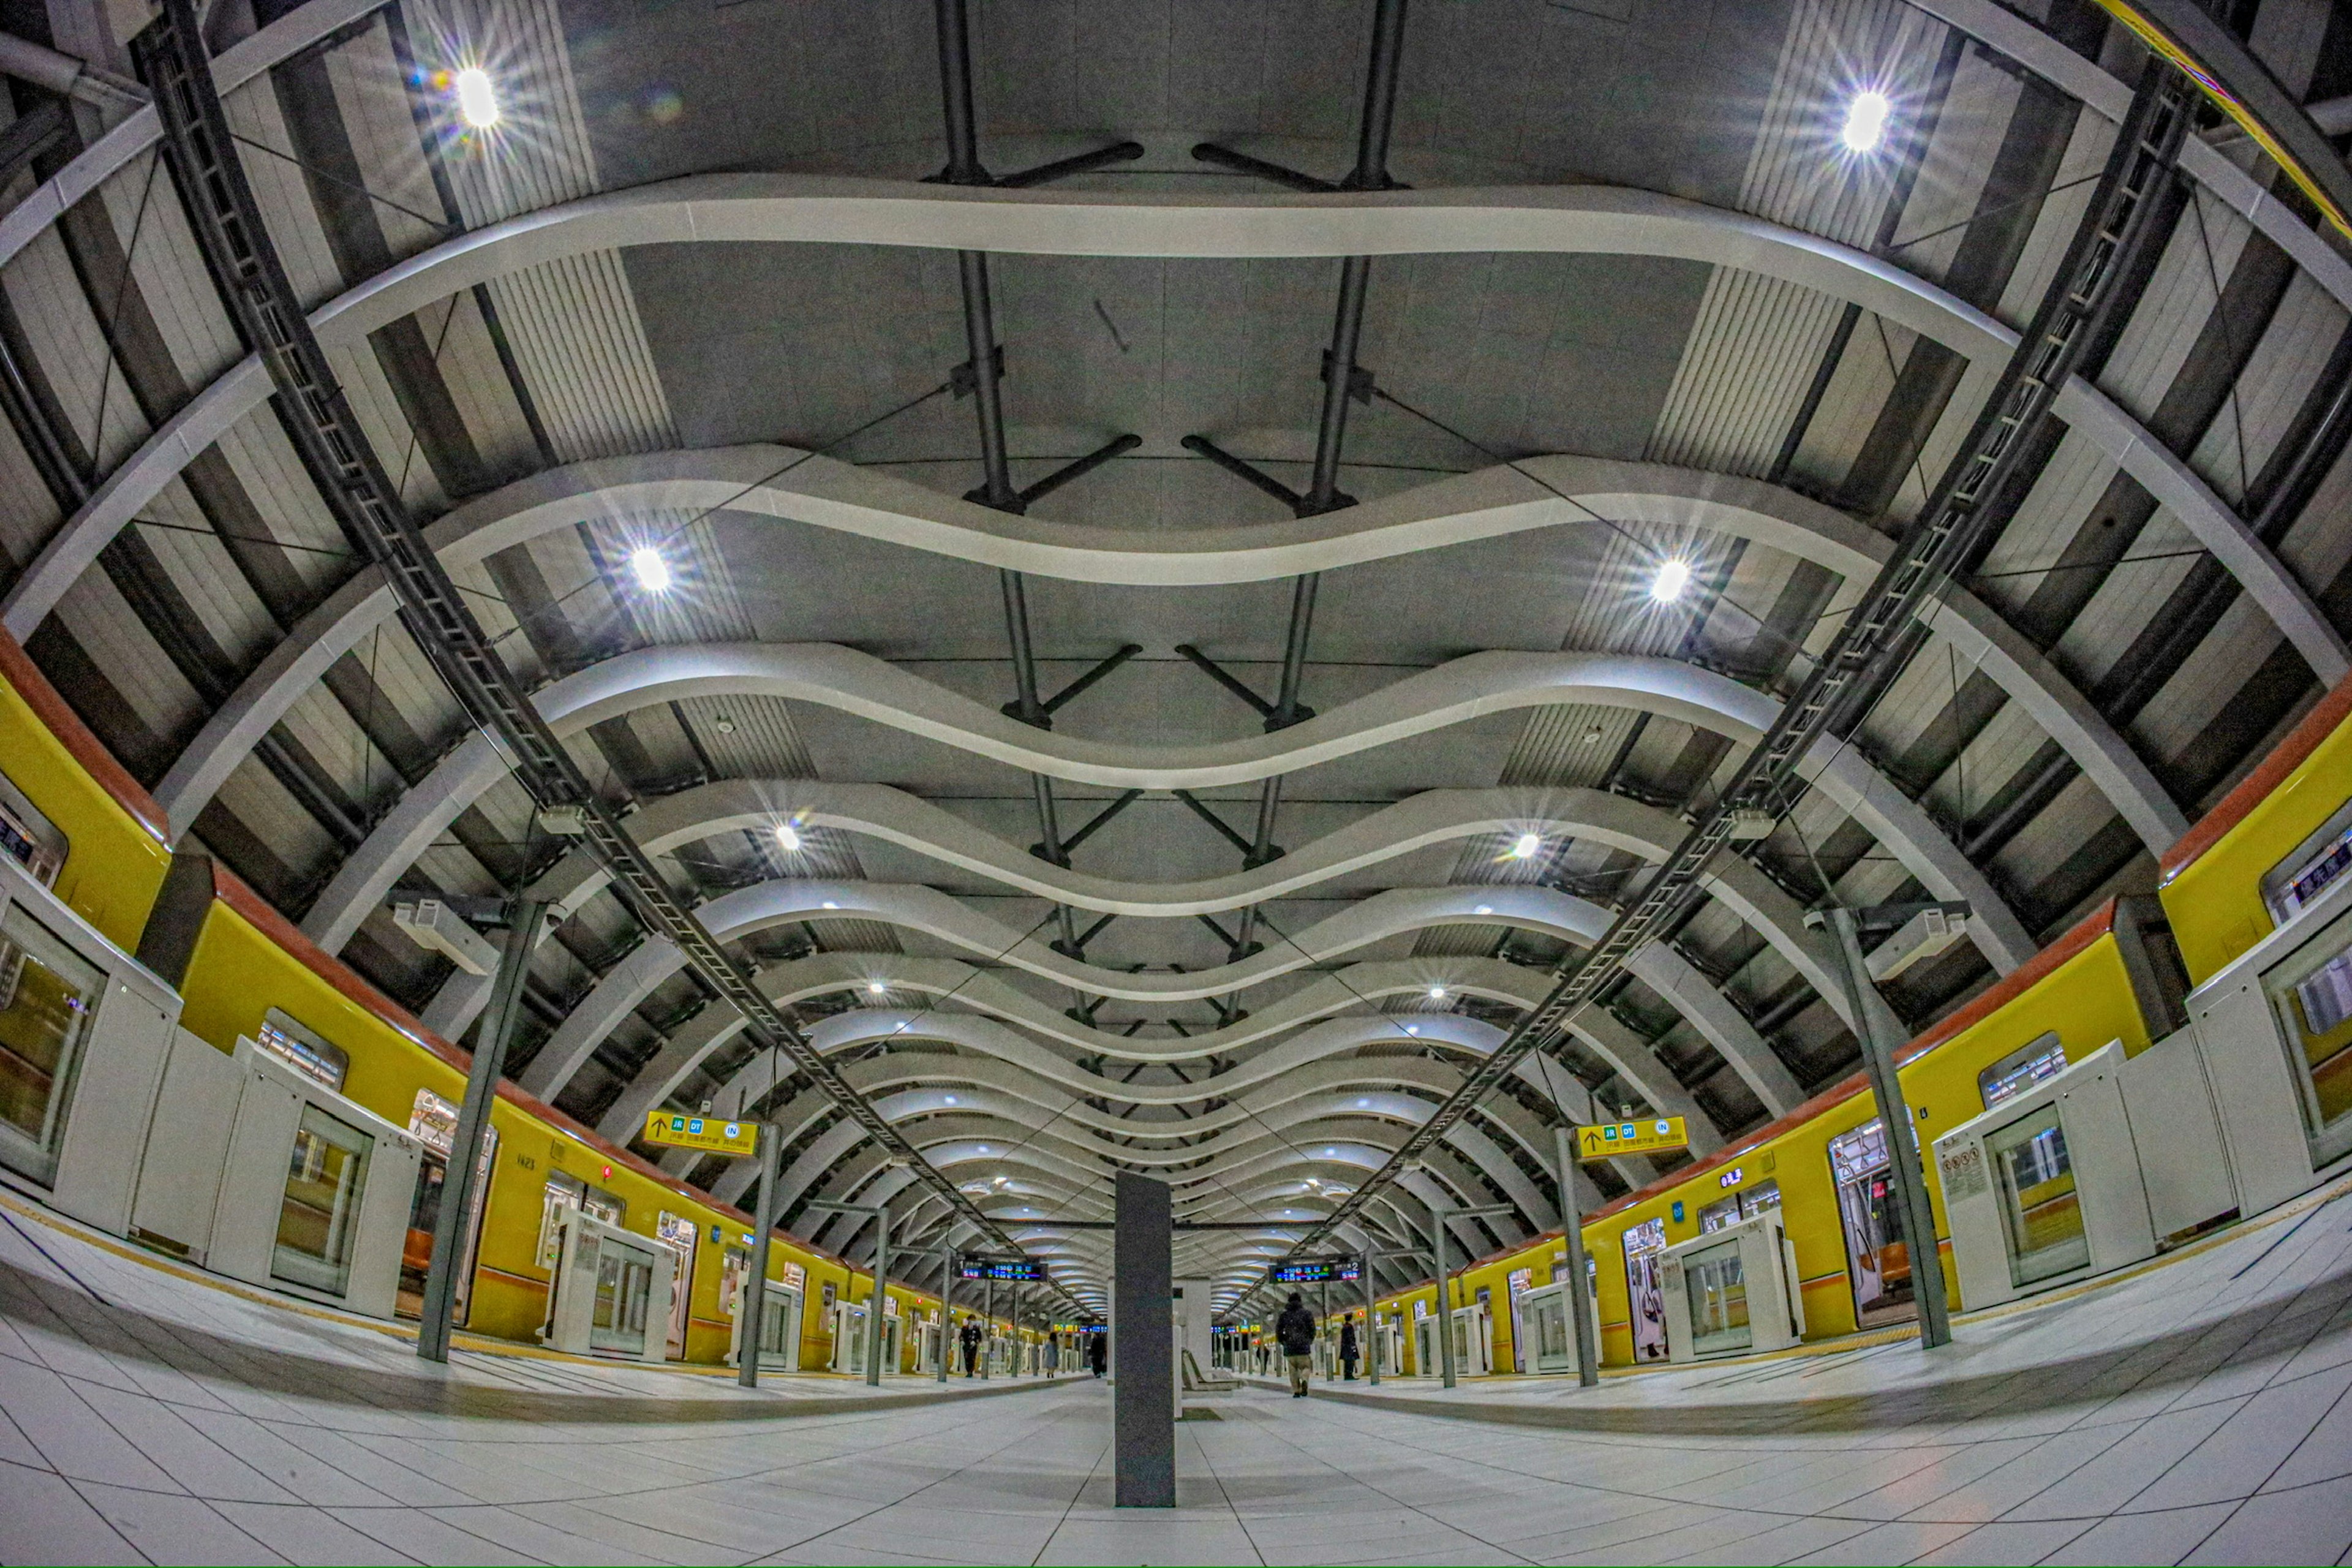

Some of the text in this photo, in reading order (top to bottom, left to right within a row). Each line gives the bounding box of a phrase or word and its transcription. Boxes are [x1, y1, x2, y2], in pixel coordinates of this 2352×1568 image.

[673, 1120, 682, 1129] JR
[690, 1121, 701, 1131] DT
[1658, 1123, 1667, 1132] IN
[727, 1127, 737, 1136] IN
[1606, 1128, 1615, 1137] JR
[1623, 1126, 1633, 1136] DT
[960, 1261, 963, 1269] 1
[1352, 1262, 1359, 1271] 2
